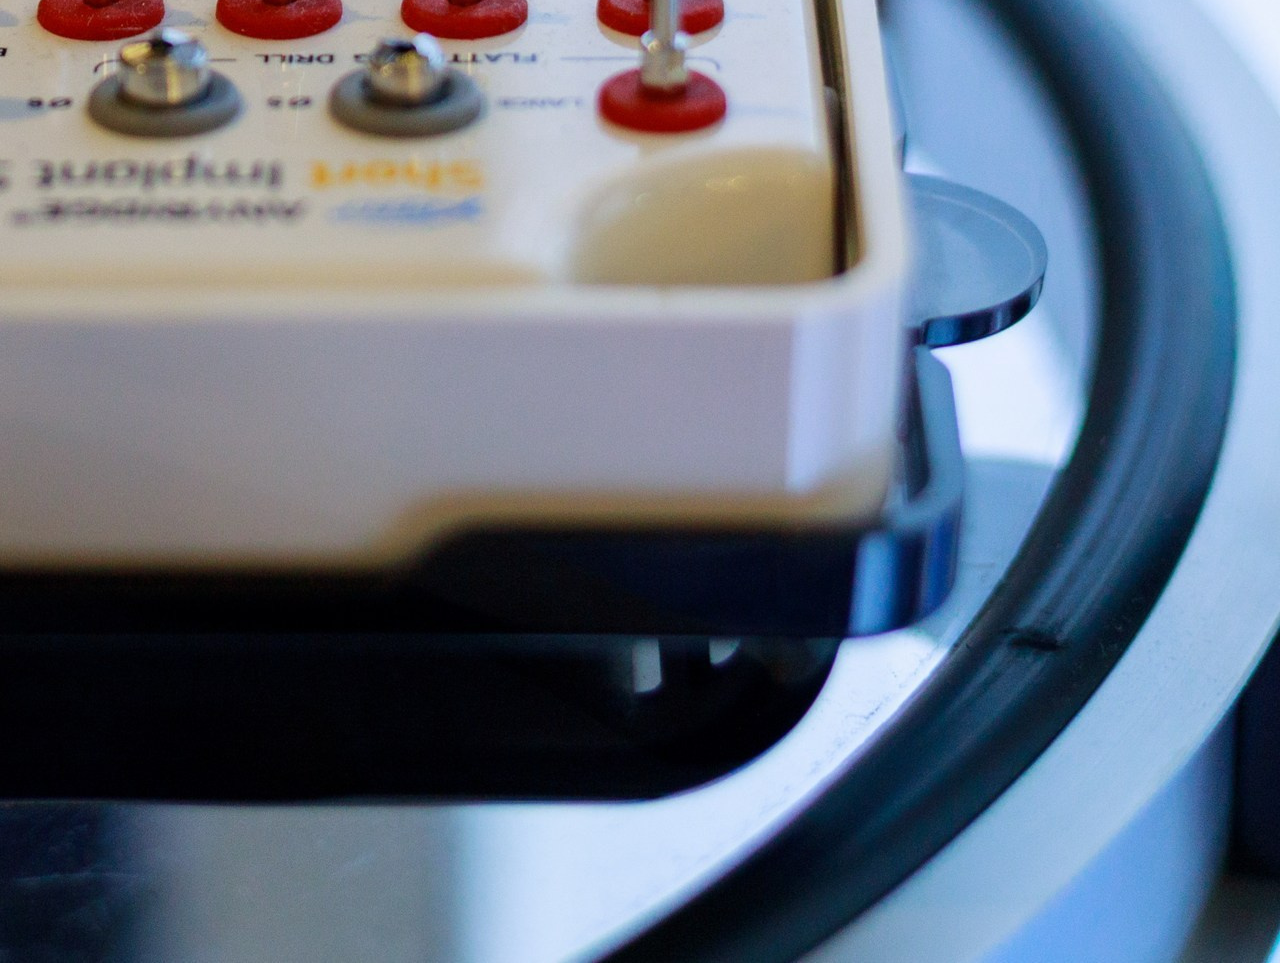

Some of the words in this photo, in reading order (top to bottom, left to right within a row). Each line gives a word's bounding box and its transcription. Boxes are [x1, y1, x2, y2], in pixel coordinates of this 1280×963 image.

[255, 53, 335, 65] DRILL
[353, 52, 538, 65] FLATTG
[30, 153, 283, 191] Implant
[312, 159, 484, 191] Short
